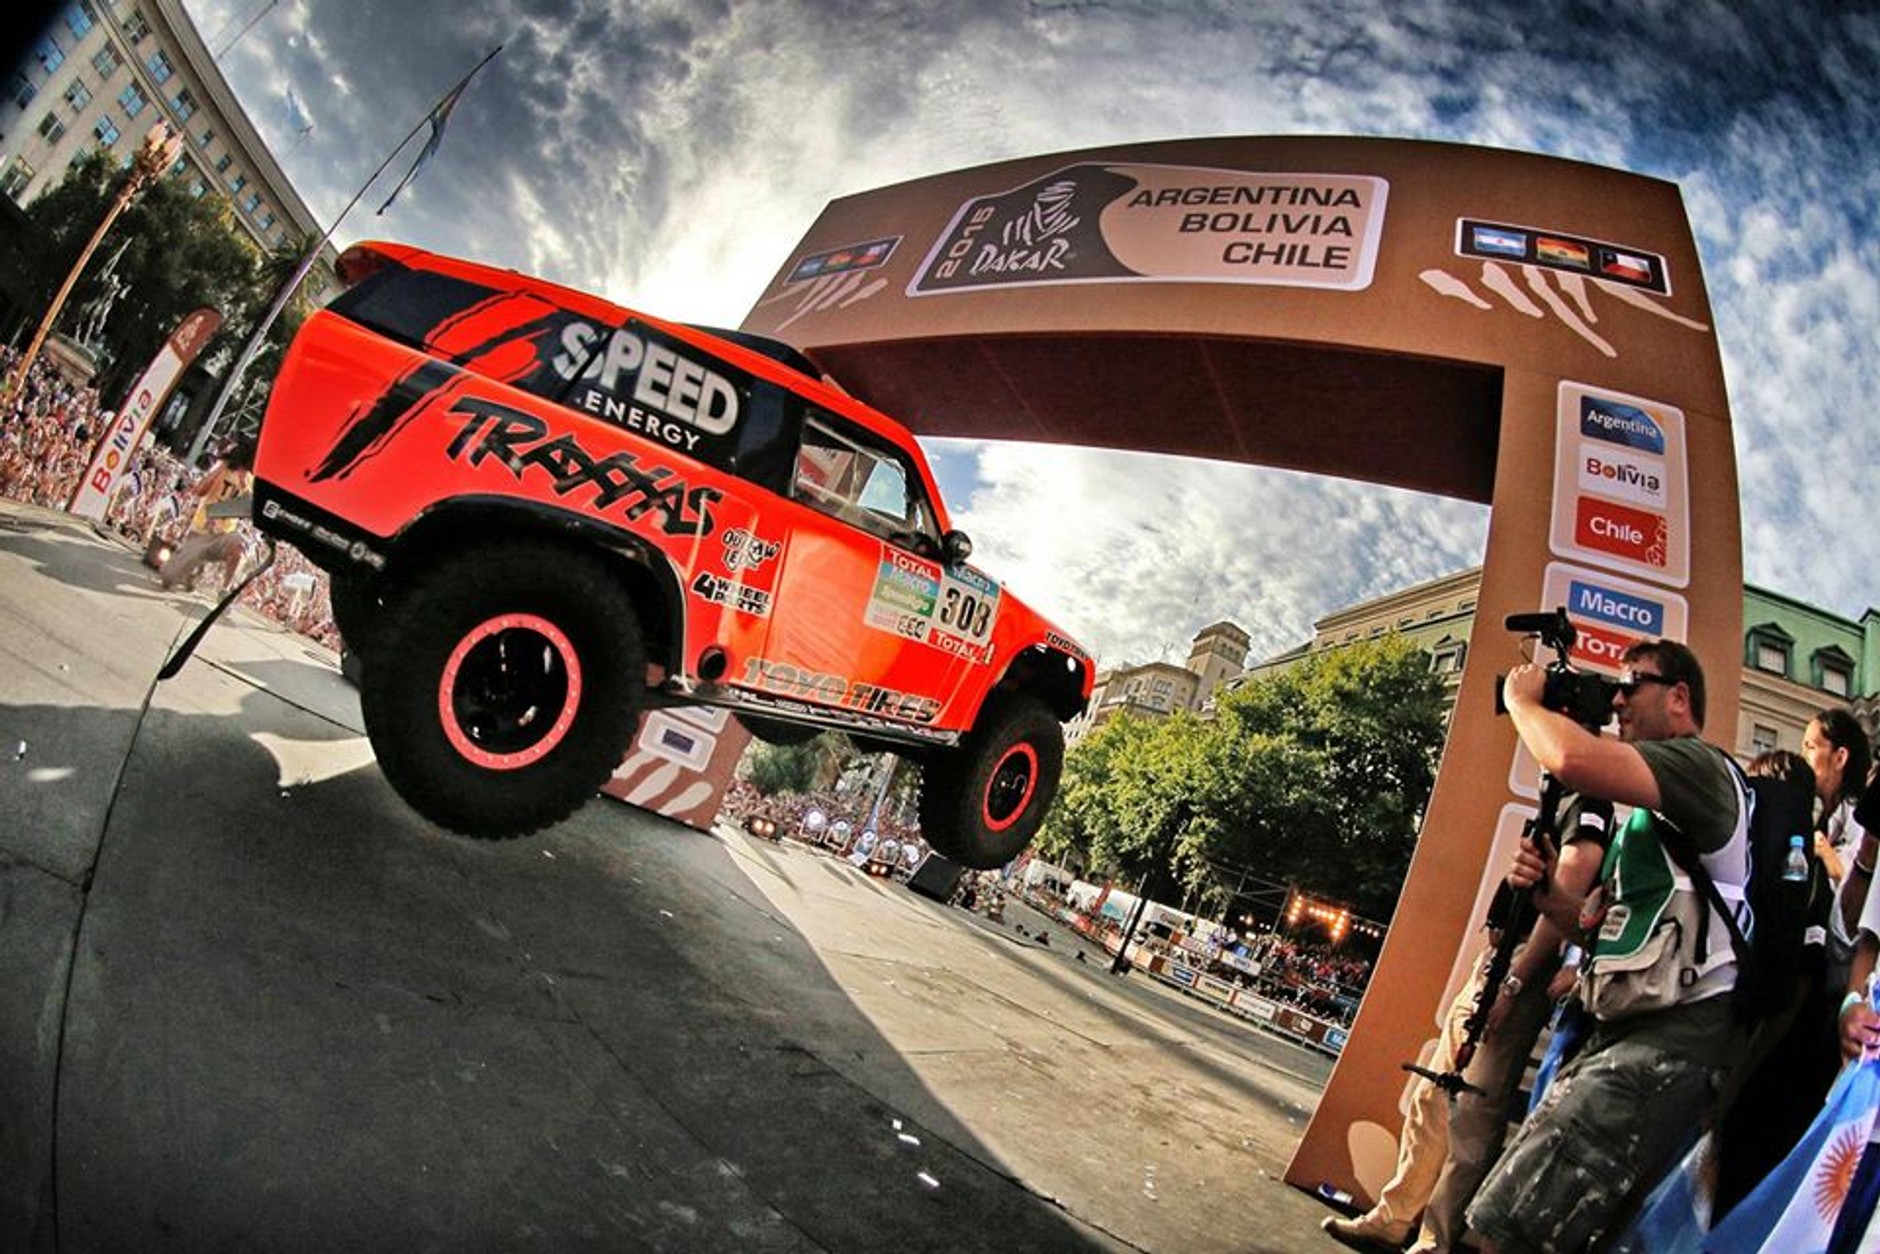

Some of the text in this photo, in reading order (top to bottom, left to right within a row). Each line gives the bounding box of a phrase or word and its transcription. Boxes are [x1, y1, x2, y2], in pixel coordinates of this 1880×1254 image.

[1127, 186, 1362, 208] ARGENTINA
[1179, 213, 1353, 237] BOLIVIA
[935, 206, 996, 279] 2015
[968, 239, 1070, 276] DAKAR
[1222, 242, 1351, 270] CHILE
[553, 322, 739, 436] SPEED
[584, 390, 701, 452] ENERGY
[1587, 409, 1657, 438] Argentina
[1590, 516, 1643, 545] Chile
[889, 549, 937, 582] TOTAL
[693, 573, 715, 600] 4
[714, 591, 766, 615] PRTS
[1580, 589, 1653, 625] Macro
[935, 631, 977, 662] TOTAL
[1575, 629, 1630, 661] TOT
[746, 658, 942, 722] TOYO TIRES
